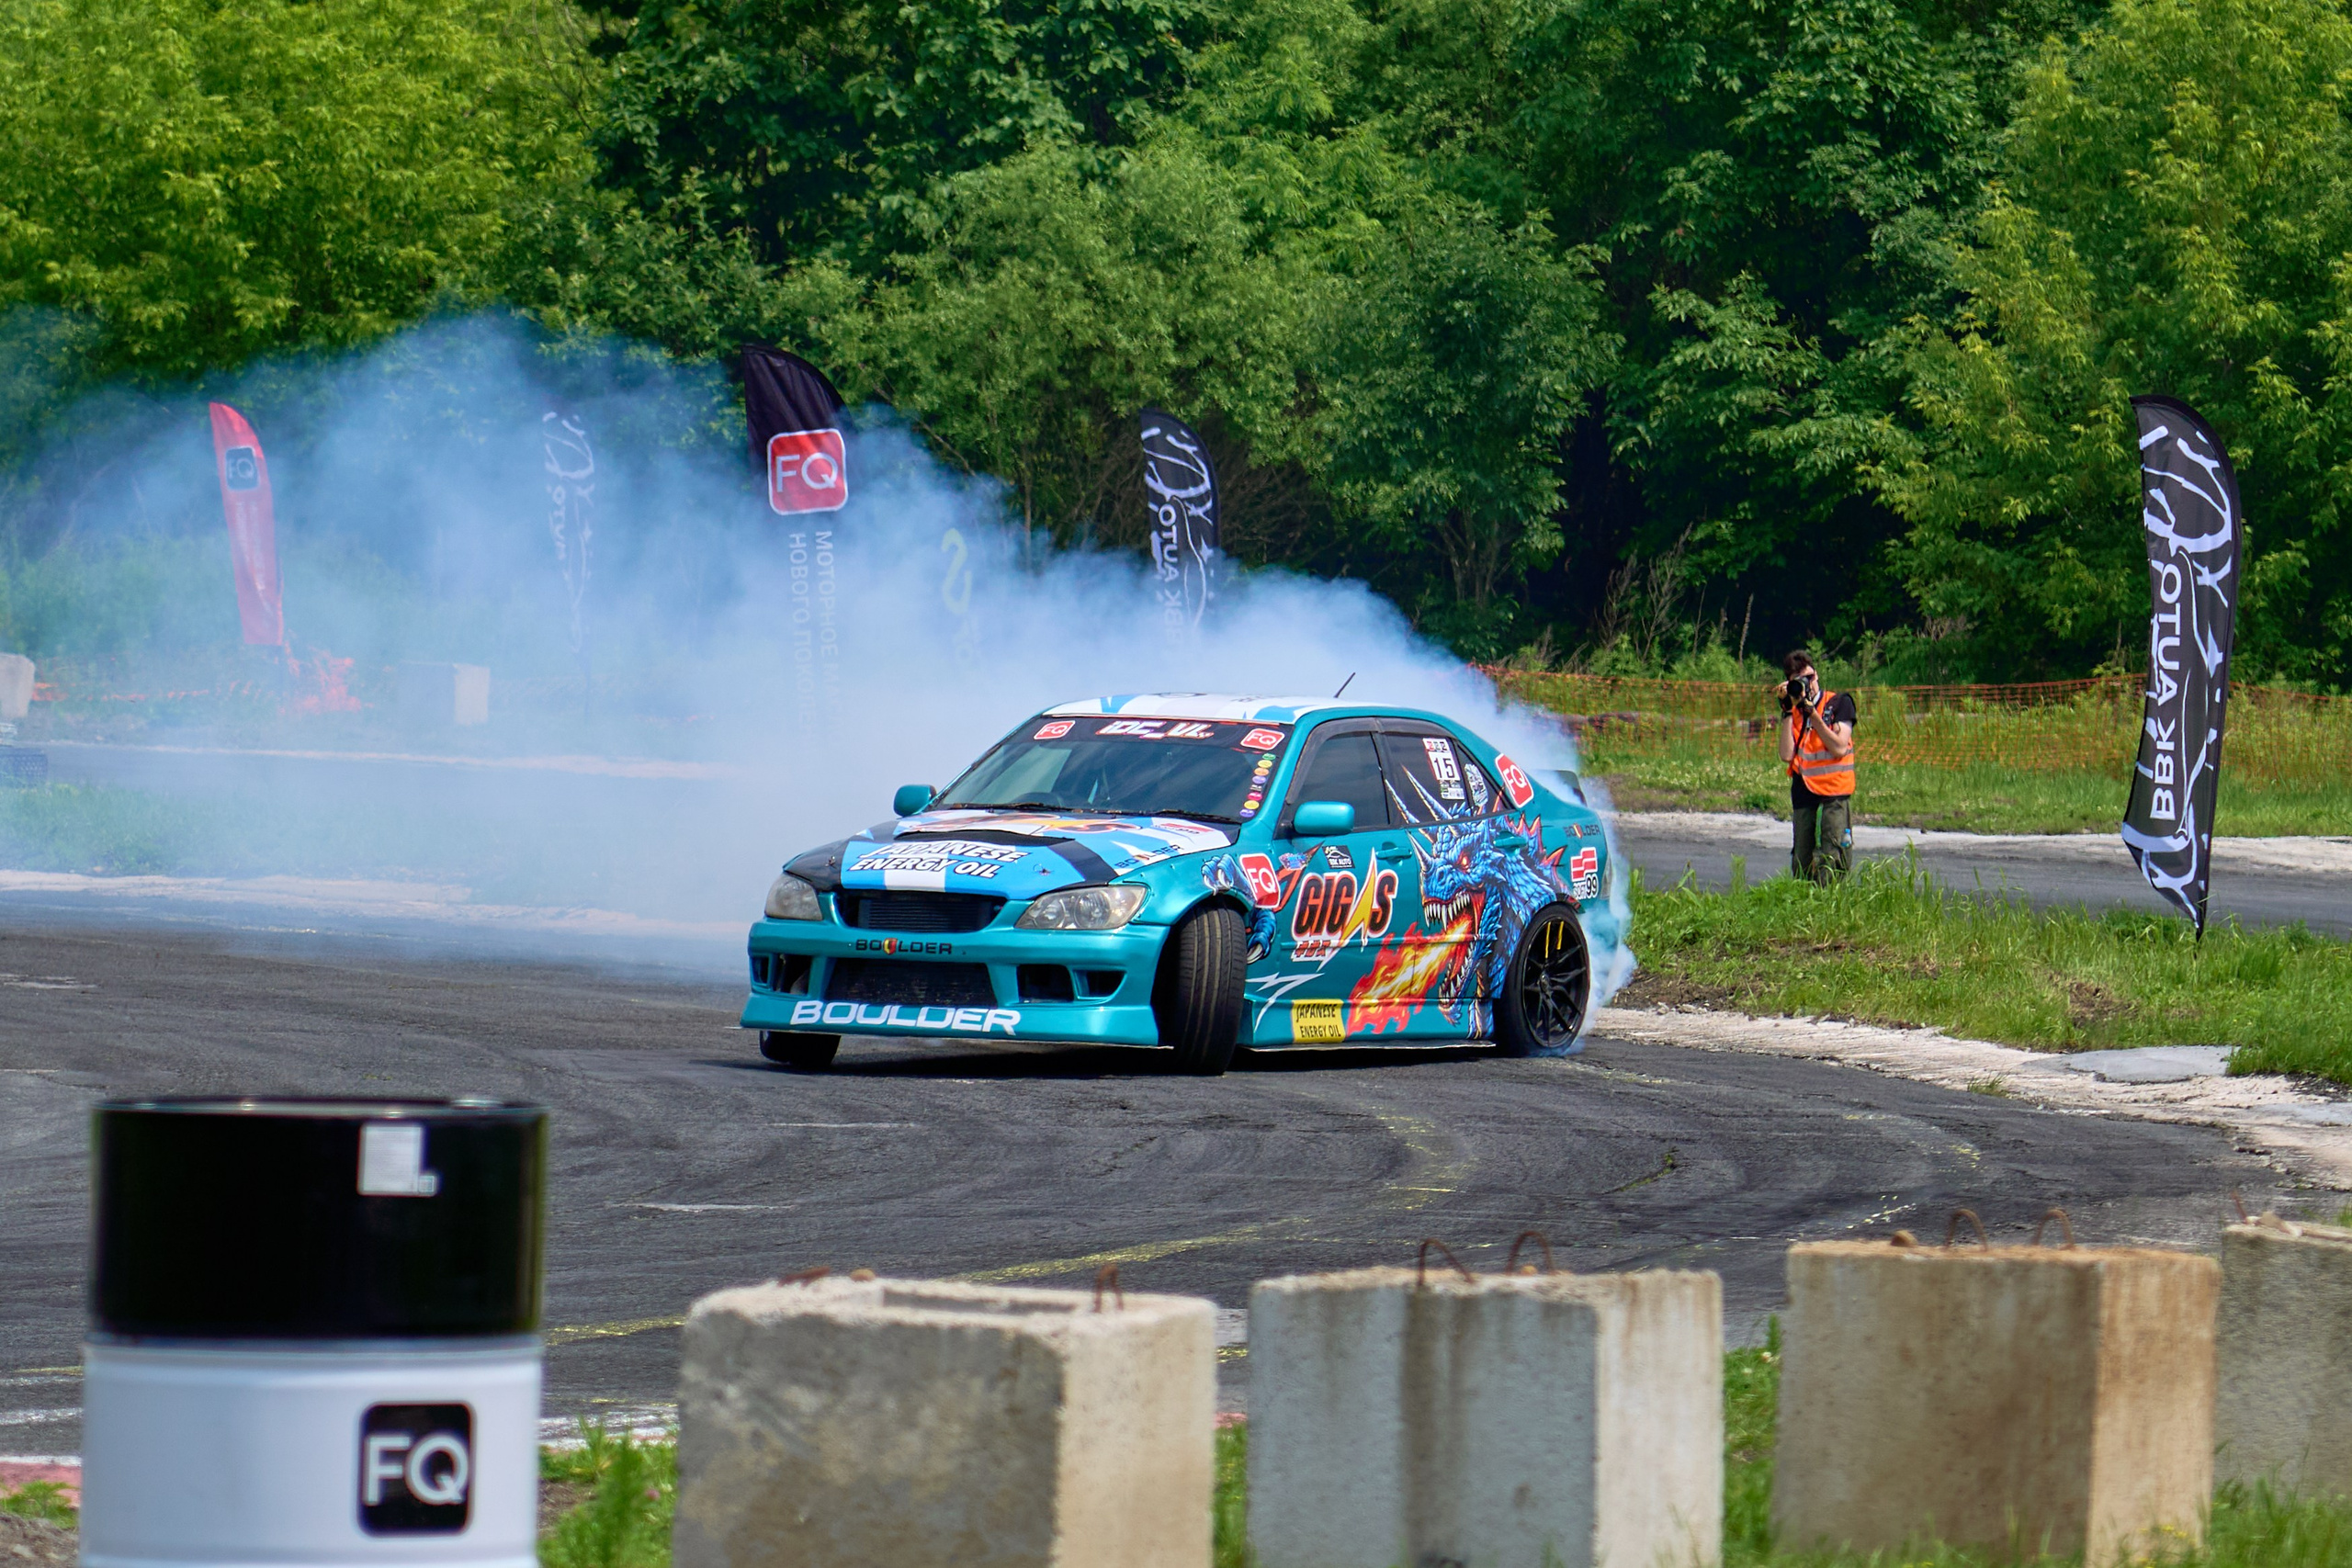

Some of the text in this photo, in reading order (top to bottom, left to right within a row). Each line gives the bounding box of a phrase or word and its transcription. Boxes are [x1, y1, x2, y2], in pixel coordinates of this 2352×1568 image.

[775, 452, 838, 492] FQ
[789, 533, 811, 626] НОВОГО
[816, 531, 840, 658] МОТОРНОЕ
[1042, 724, 1069, 736] FQ
[1247, 731, 1278, 745] FQ
[1434, 758, 1455, 780] 15
[1503, 764, 1527, 795] FQ
[858, 841, 1032, 863] JAPANESE
[848, 856, 1003, 879] ENERGY OIL
[1247, 867, 1276, 894] FQ
[1293, 854, 1398, 941] GIGAS
[790, 1000, 1022, 1036] BOULDER
[1295, 1003, 1338, 1023] JAPANESE
[1300, 1024, 1341, 1038] ENERGY OIL
[362, 1434, 469, 1506] FQ
